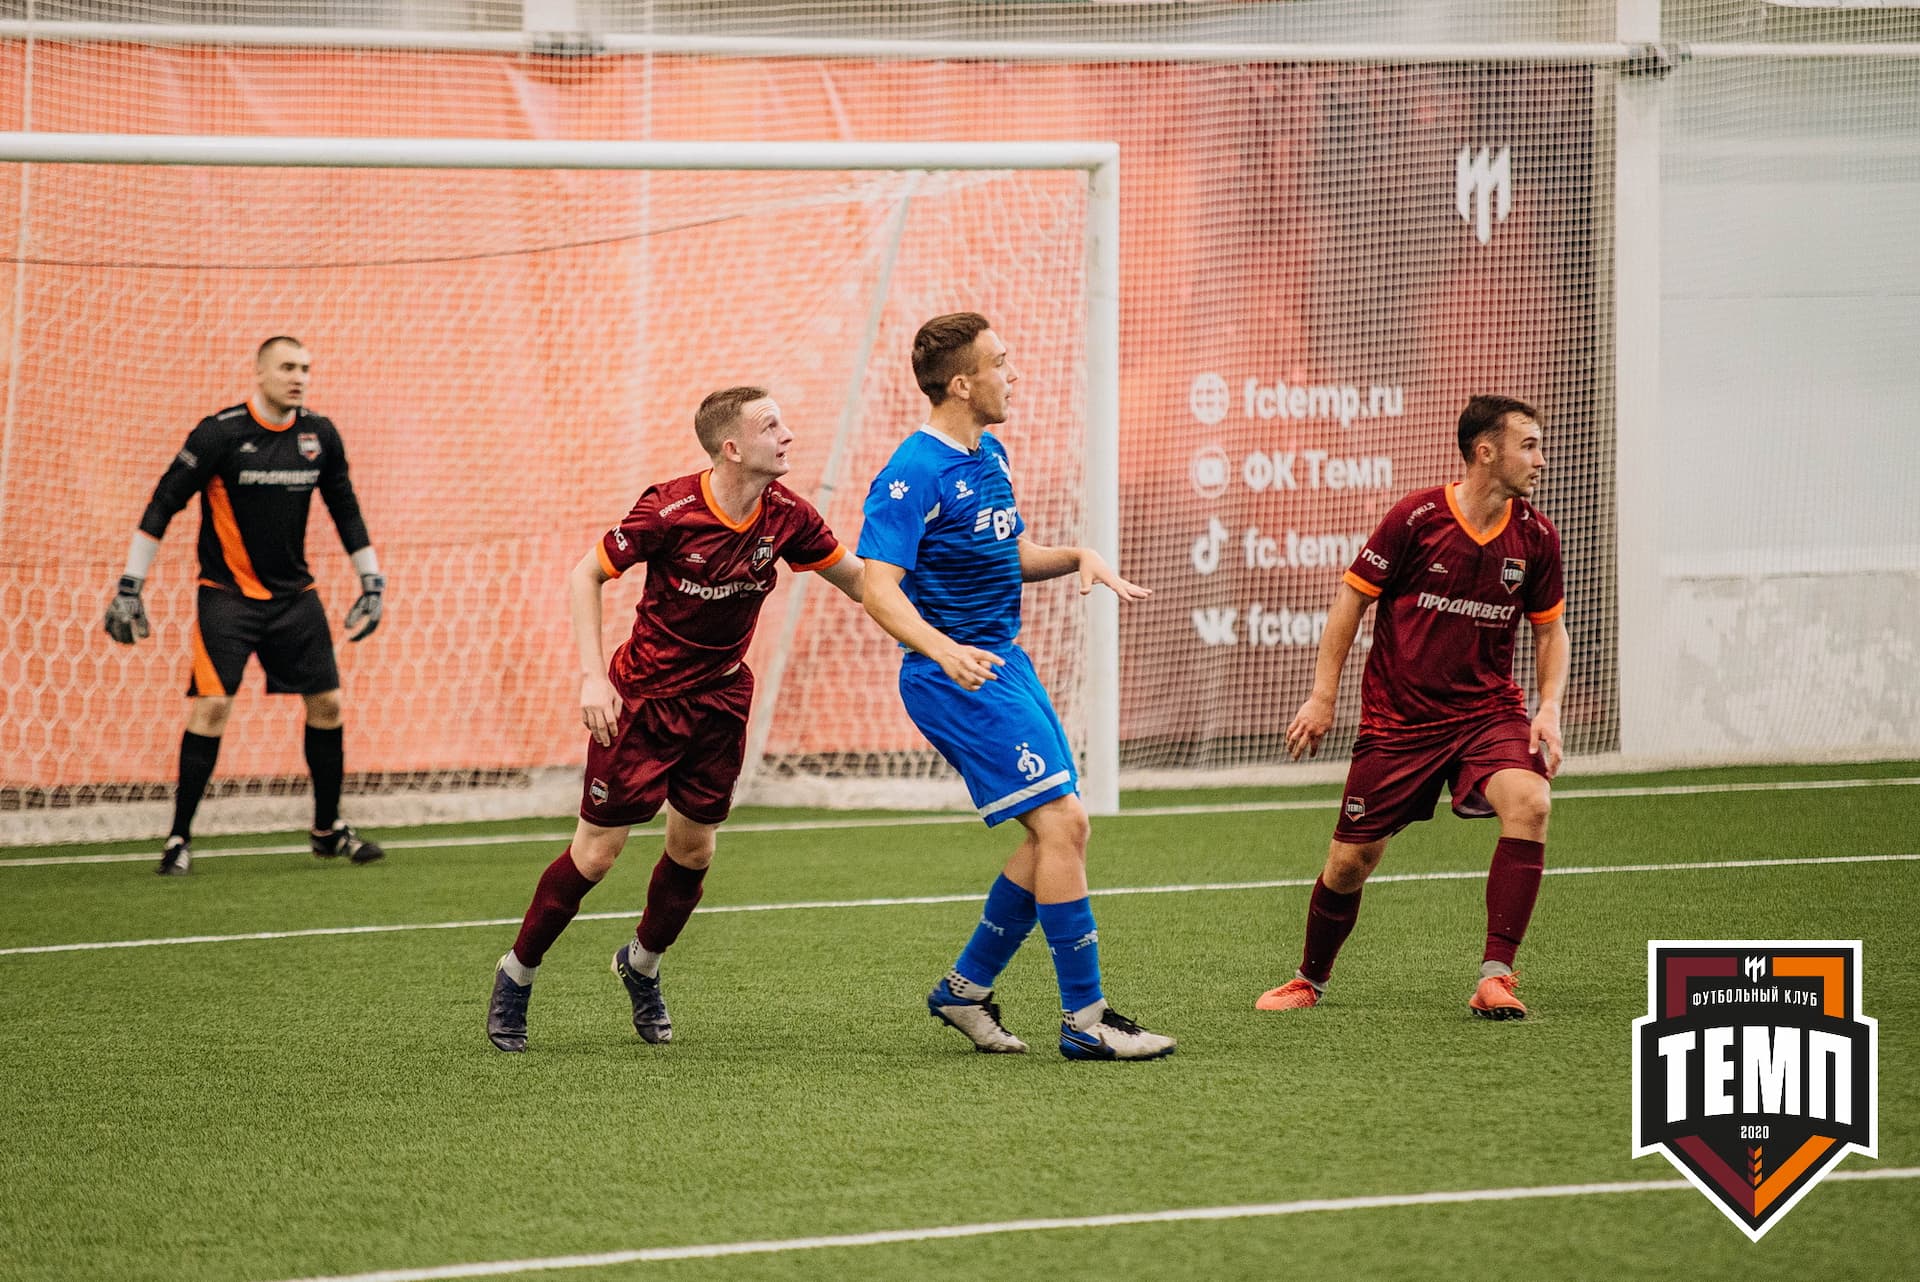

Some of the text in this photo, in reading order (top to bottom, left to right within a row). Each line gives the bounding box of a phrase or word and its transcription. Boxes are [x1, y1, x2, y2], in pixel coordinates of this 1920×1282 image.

[1244, 377, 1404, 428] fctemp.ru
[1244, 450, 1393, 491] ФК Темп
[1362, 548, 1390, 570] ПСБ
